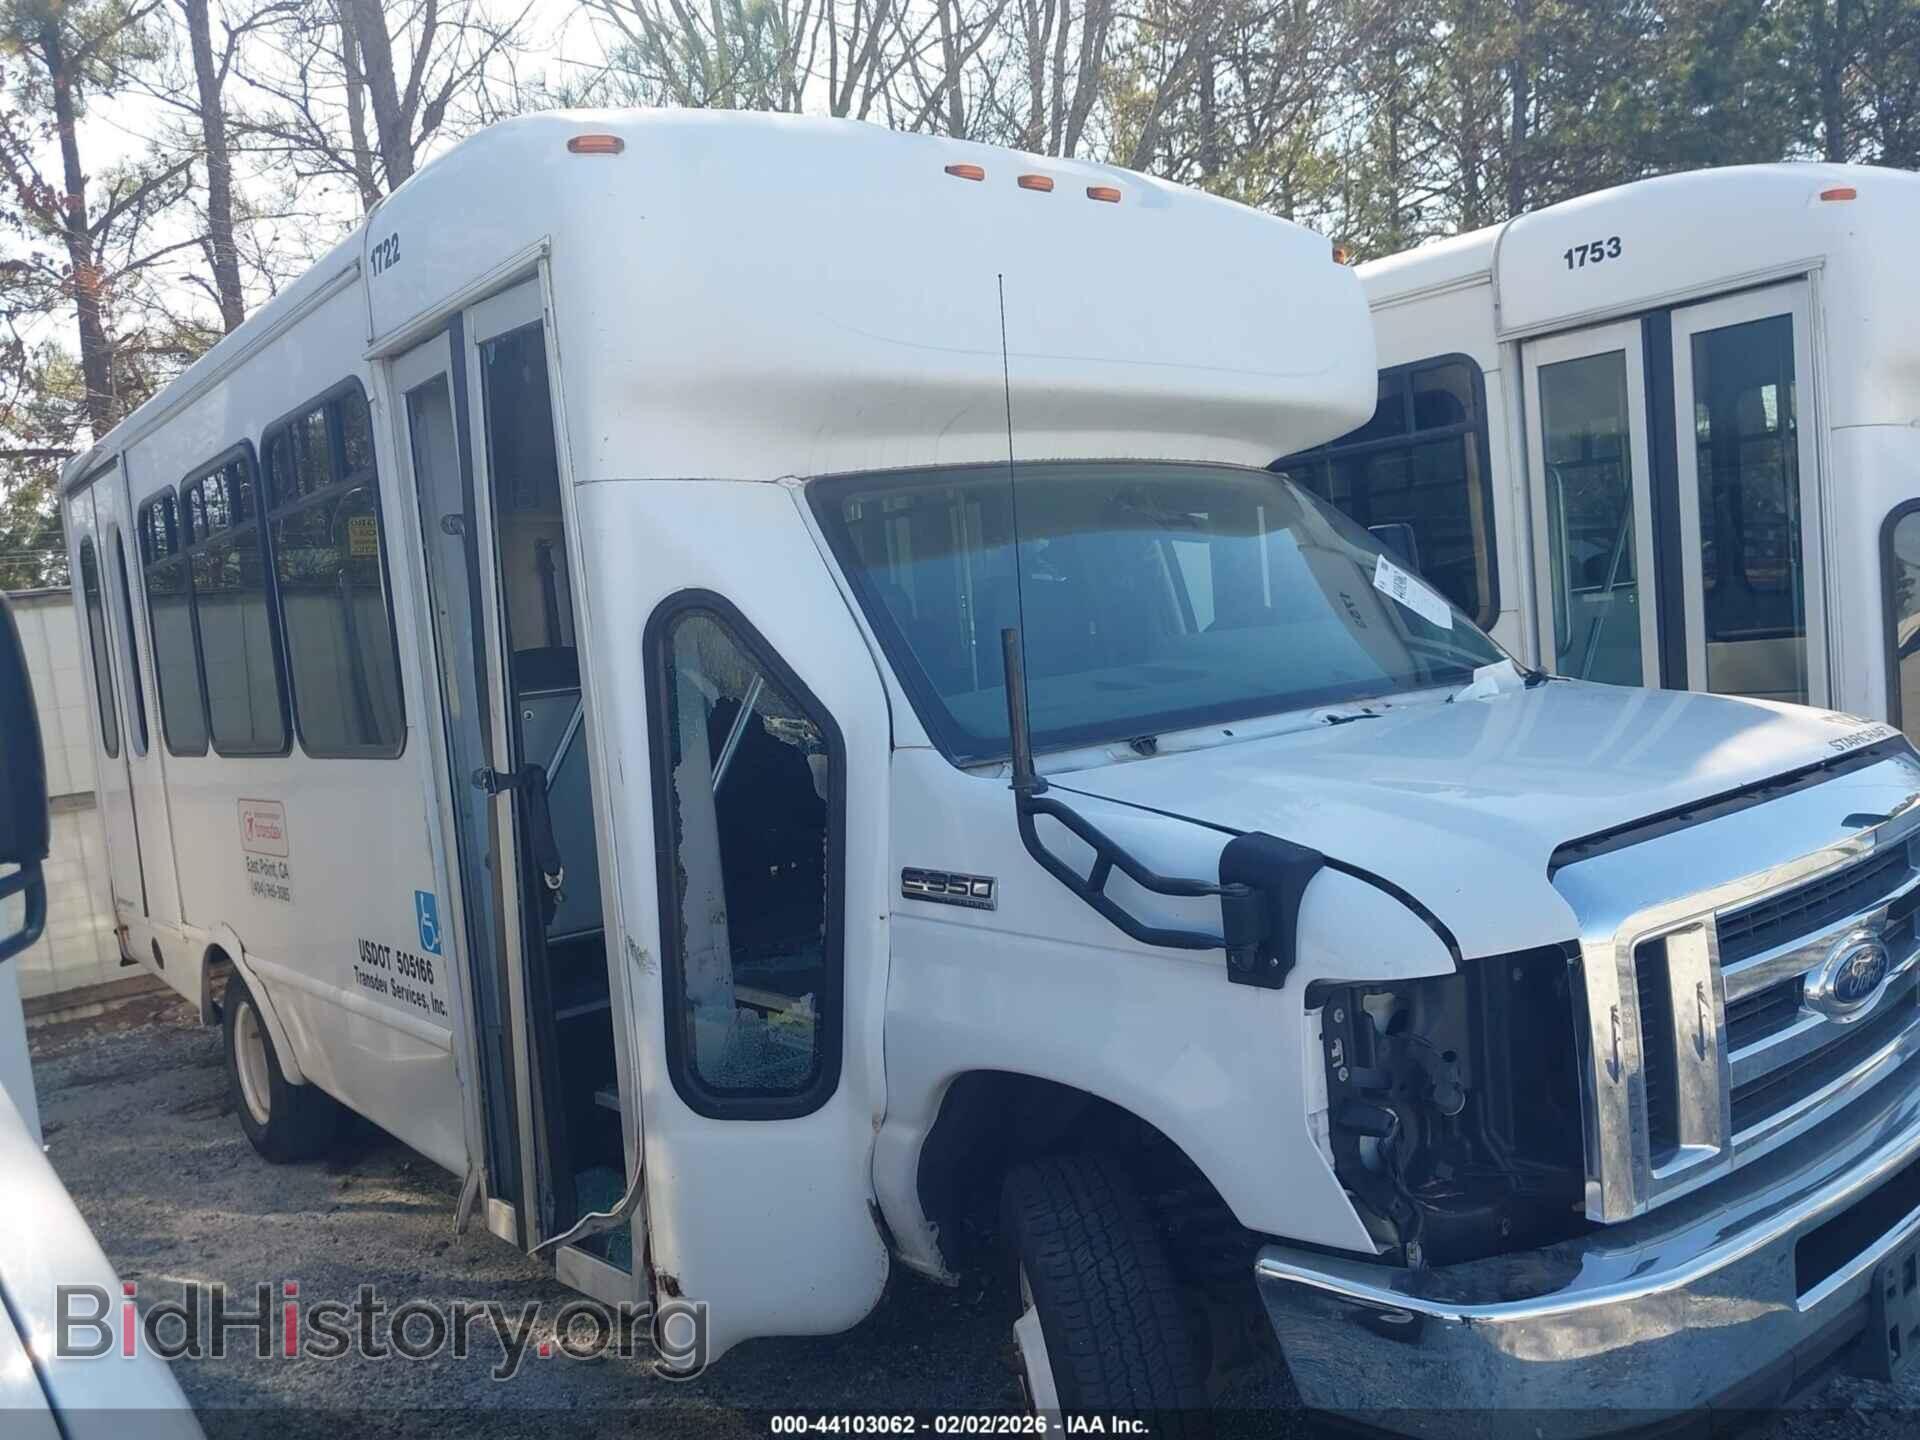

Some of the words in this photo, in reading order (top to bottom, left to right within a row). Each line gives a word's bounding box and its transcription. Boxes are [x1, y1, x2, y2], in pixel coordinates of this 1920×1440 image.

[370, 232, 400, 277] 1722
[1563, 236, 1622, 270] 1753
[359, 938, 391, 971] USDOT
[396, 950, 434, 985] 505166
[354, 964, 388, 995] Transdev
[390, 977, 430, 1014] Services,
[430, 991, 448, 1017] Inc.
